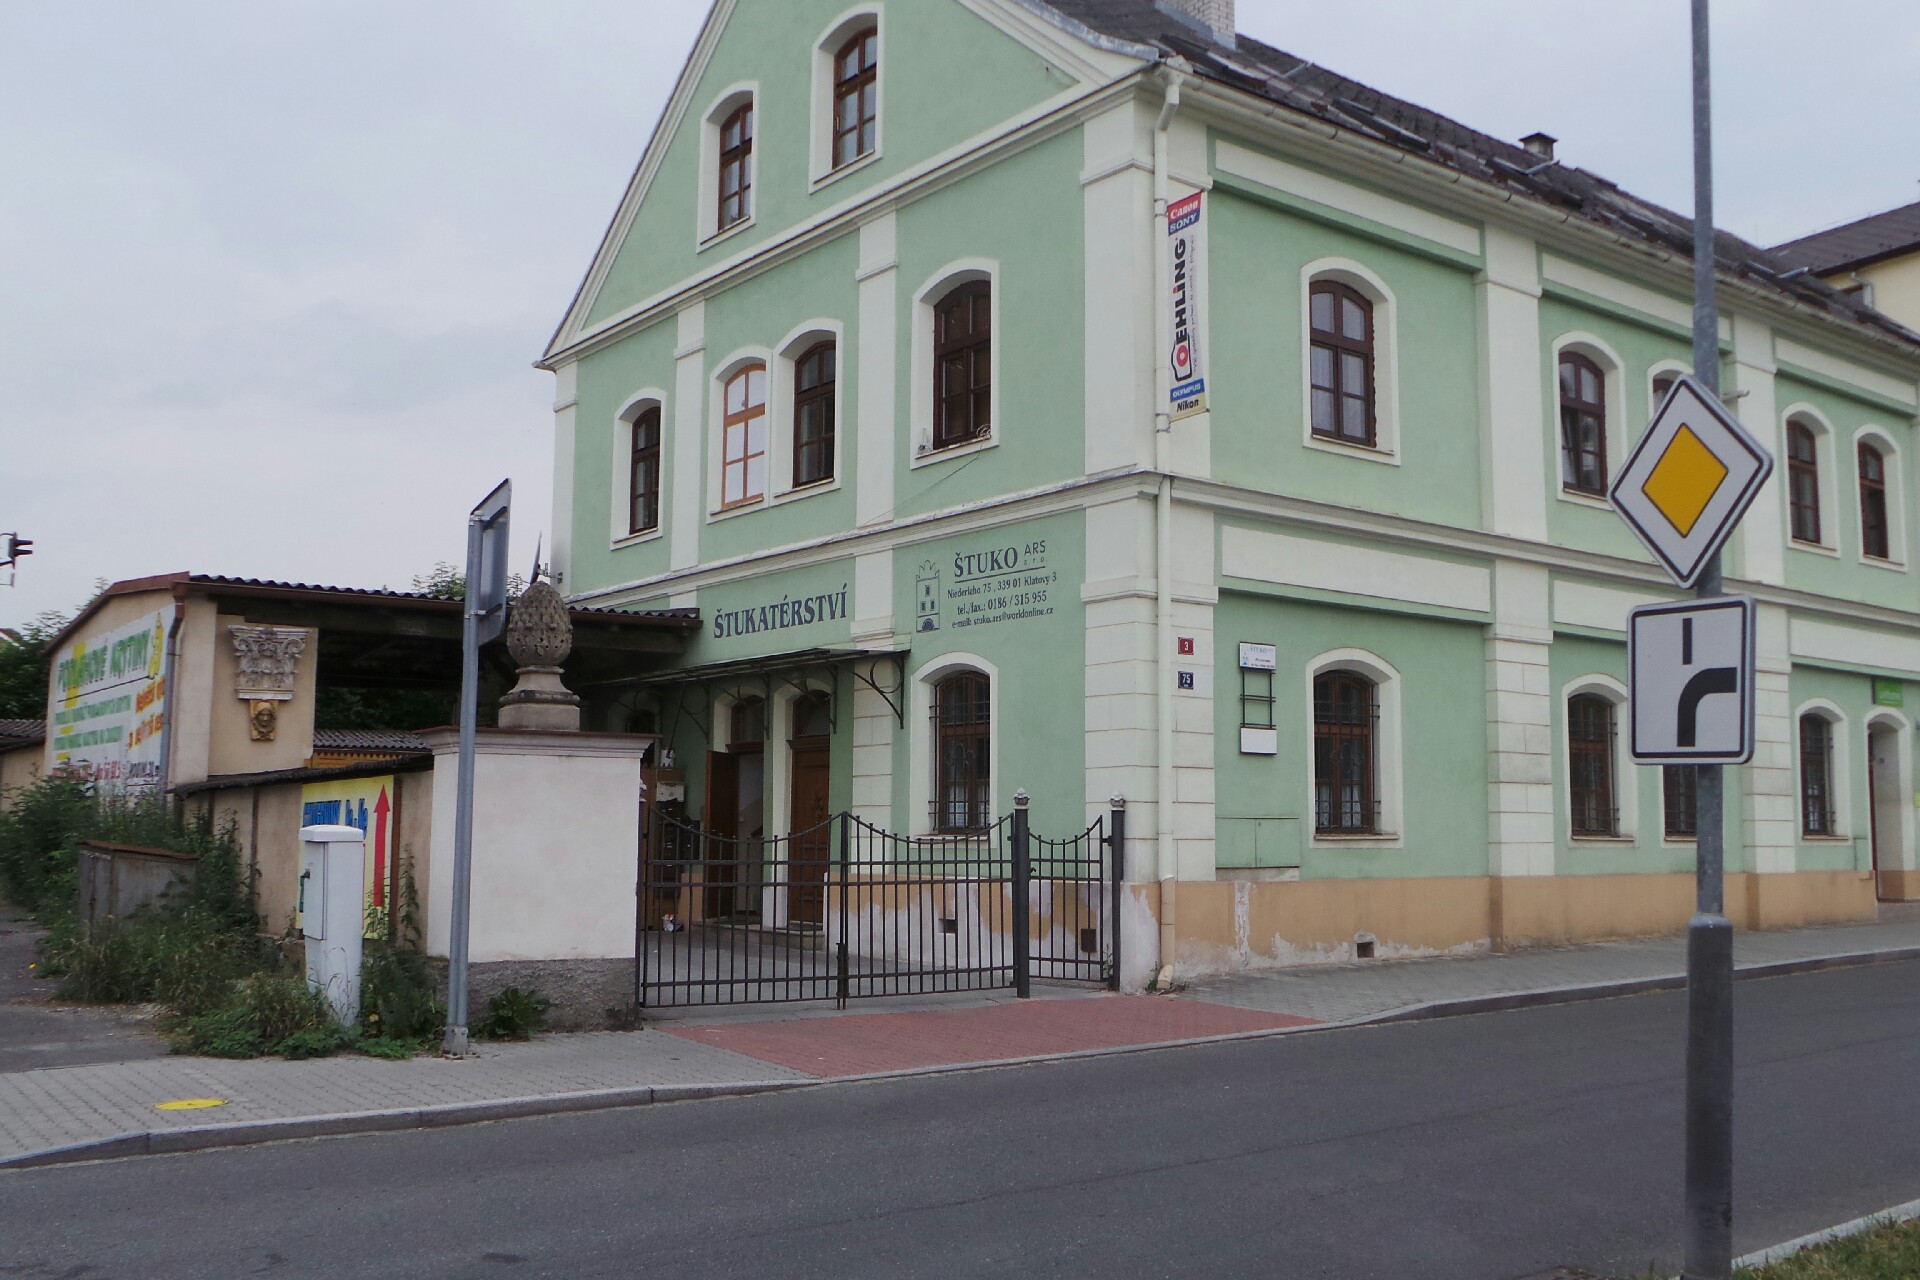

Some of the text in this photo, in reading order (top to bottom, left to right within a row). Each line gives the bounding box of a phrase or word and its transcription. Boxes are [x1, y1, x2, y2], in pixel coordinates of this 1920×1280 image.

[1170, 200, 1199, 219] Canon
[1170, 212, 1197, 233] SONY
[1172, 383, 1201, 398] OLYMPUS
[1177, 399, 1199, 412] Nikon
[954, 540, 1046, 578] ŠTUKO ARS
[983, 582, 992, 593] 75
[998, 579, 1011, 591] 339
[1013, 577, 1021, 588] 01
[1024, 575, 1050, 586] Klatovy
[1052, 571, 1057, 582] 3
[987, 596, 1007, 610] 0186
[1015, 593, 1030, 606] 315
[1031, 590, 1047, 604] 955
[713, 582, 848, 639] ŠTUKATÉRSTVÍ
[1184, 641, 1189, 651] 3
[1182, 673, 1191, 684] 75
